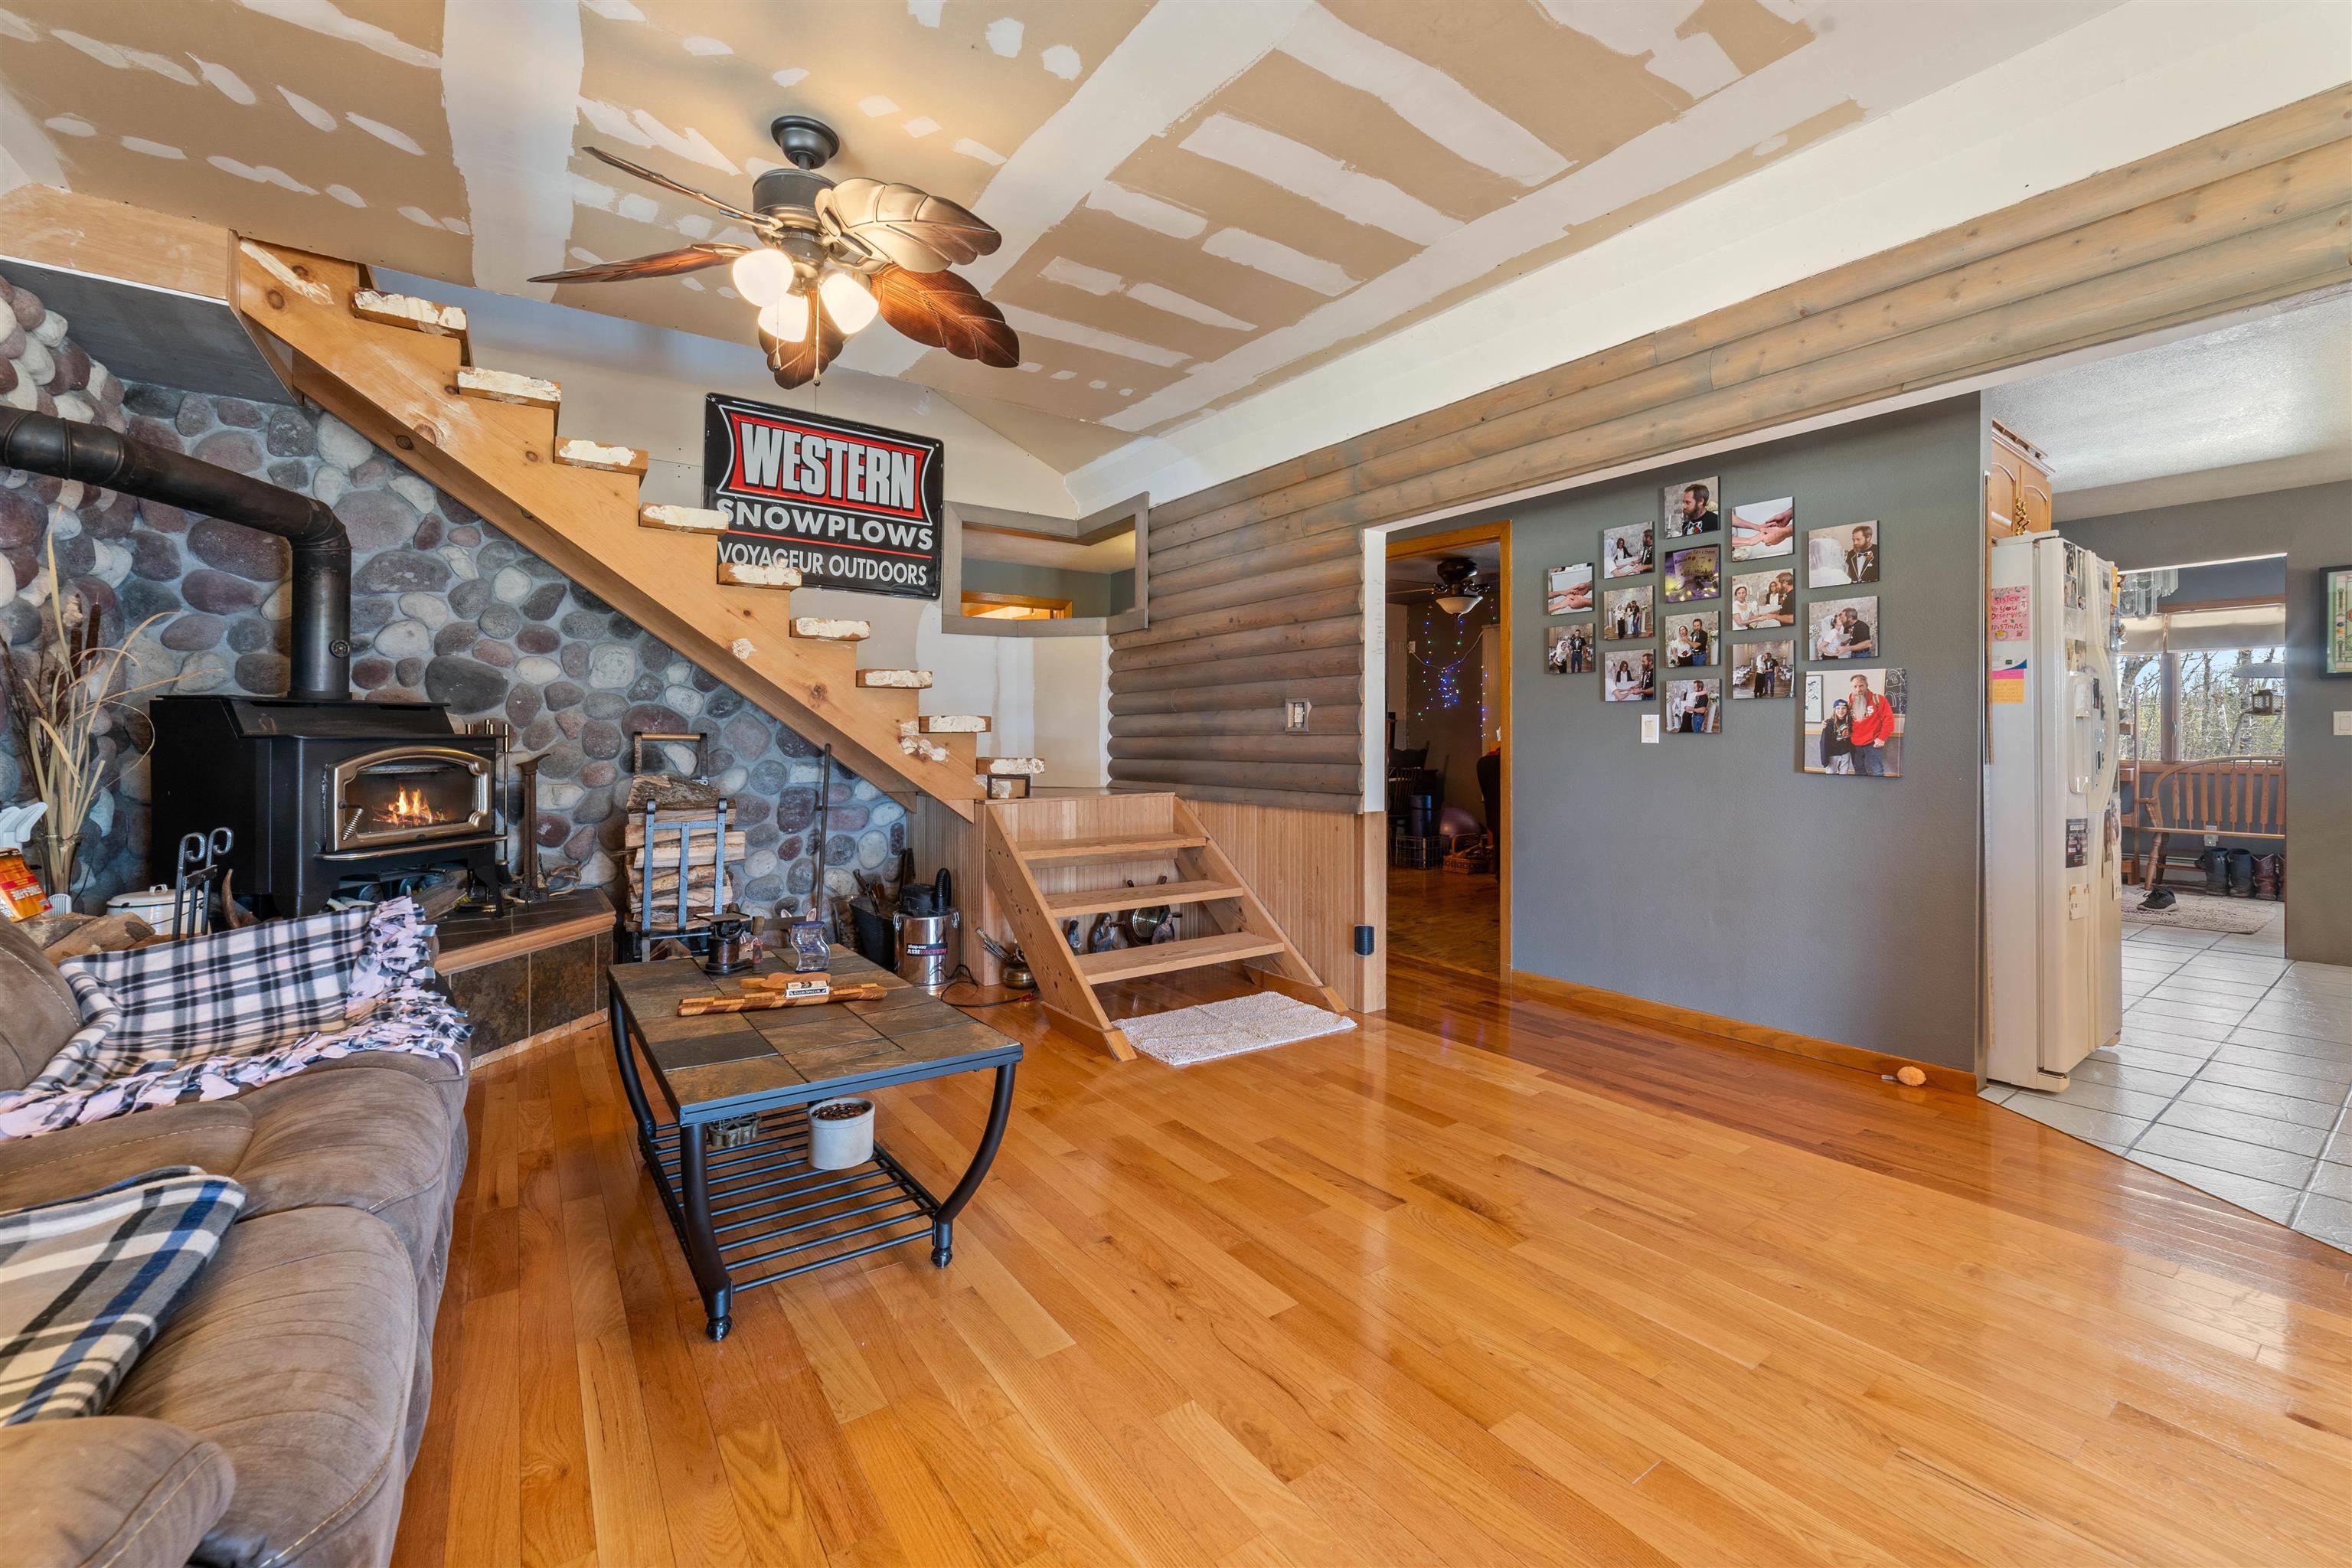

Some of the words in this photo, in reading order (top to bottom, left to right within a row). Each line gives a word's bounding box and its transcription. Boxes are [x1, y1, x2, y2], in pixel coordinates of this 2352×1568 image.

[740, 422, 915, 510] WESTERN
[717, 498, 933, 550] SNOWPLOWS
[717, 541, 824, 575] VOYAGEUR
[829, 555, 926, 586] OUTDOORS
